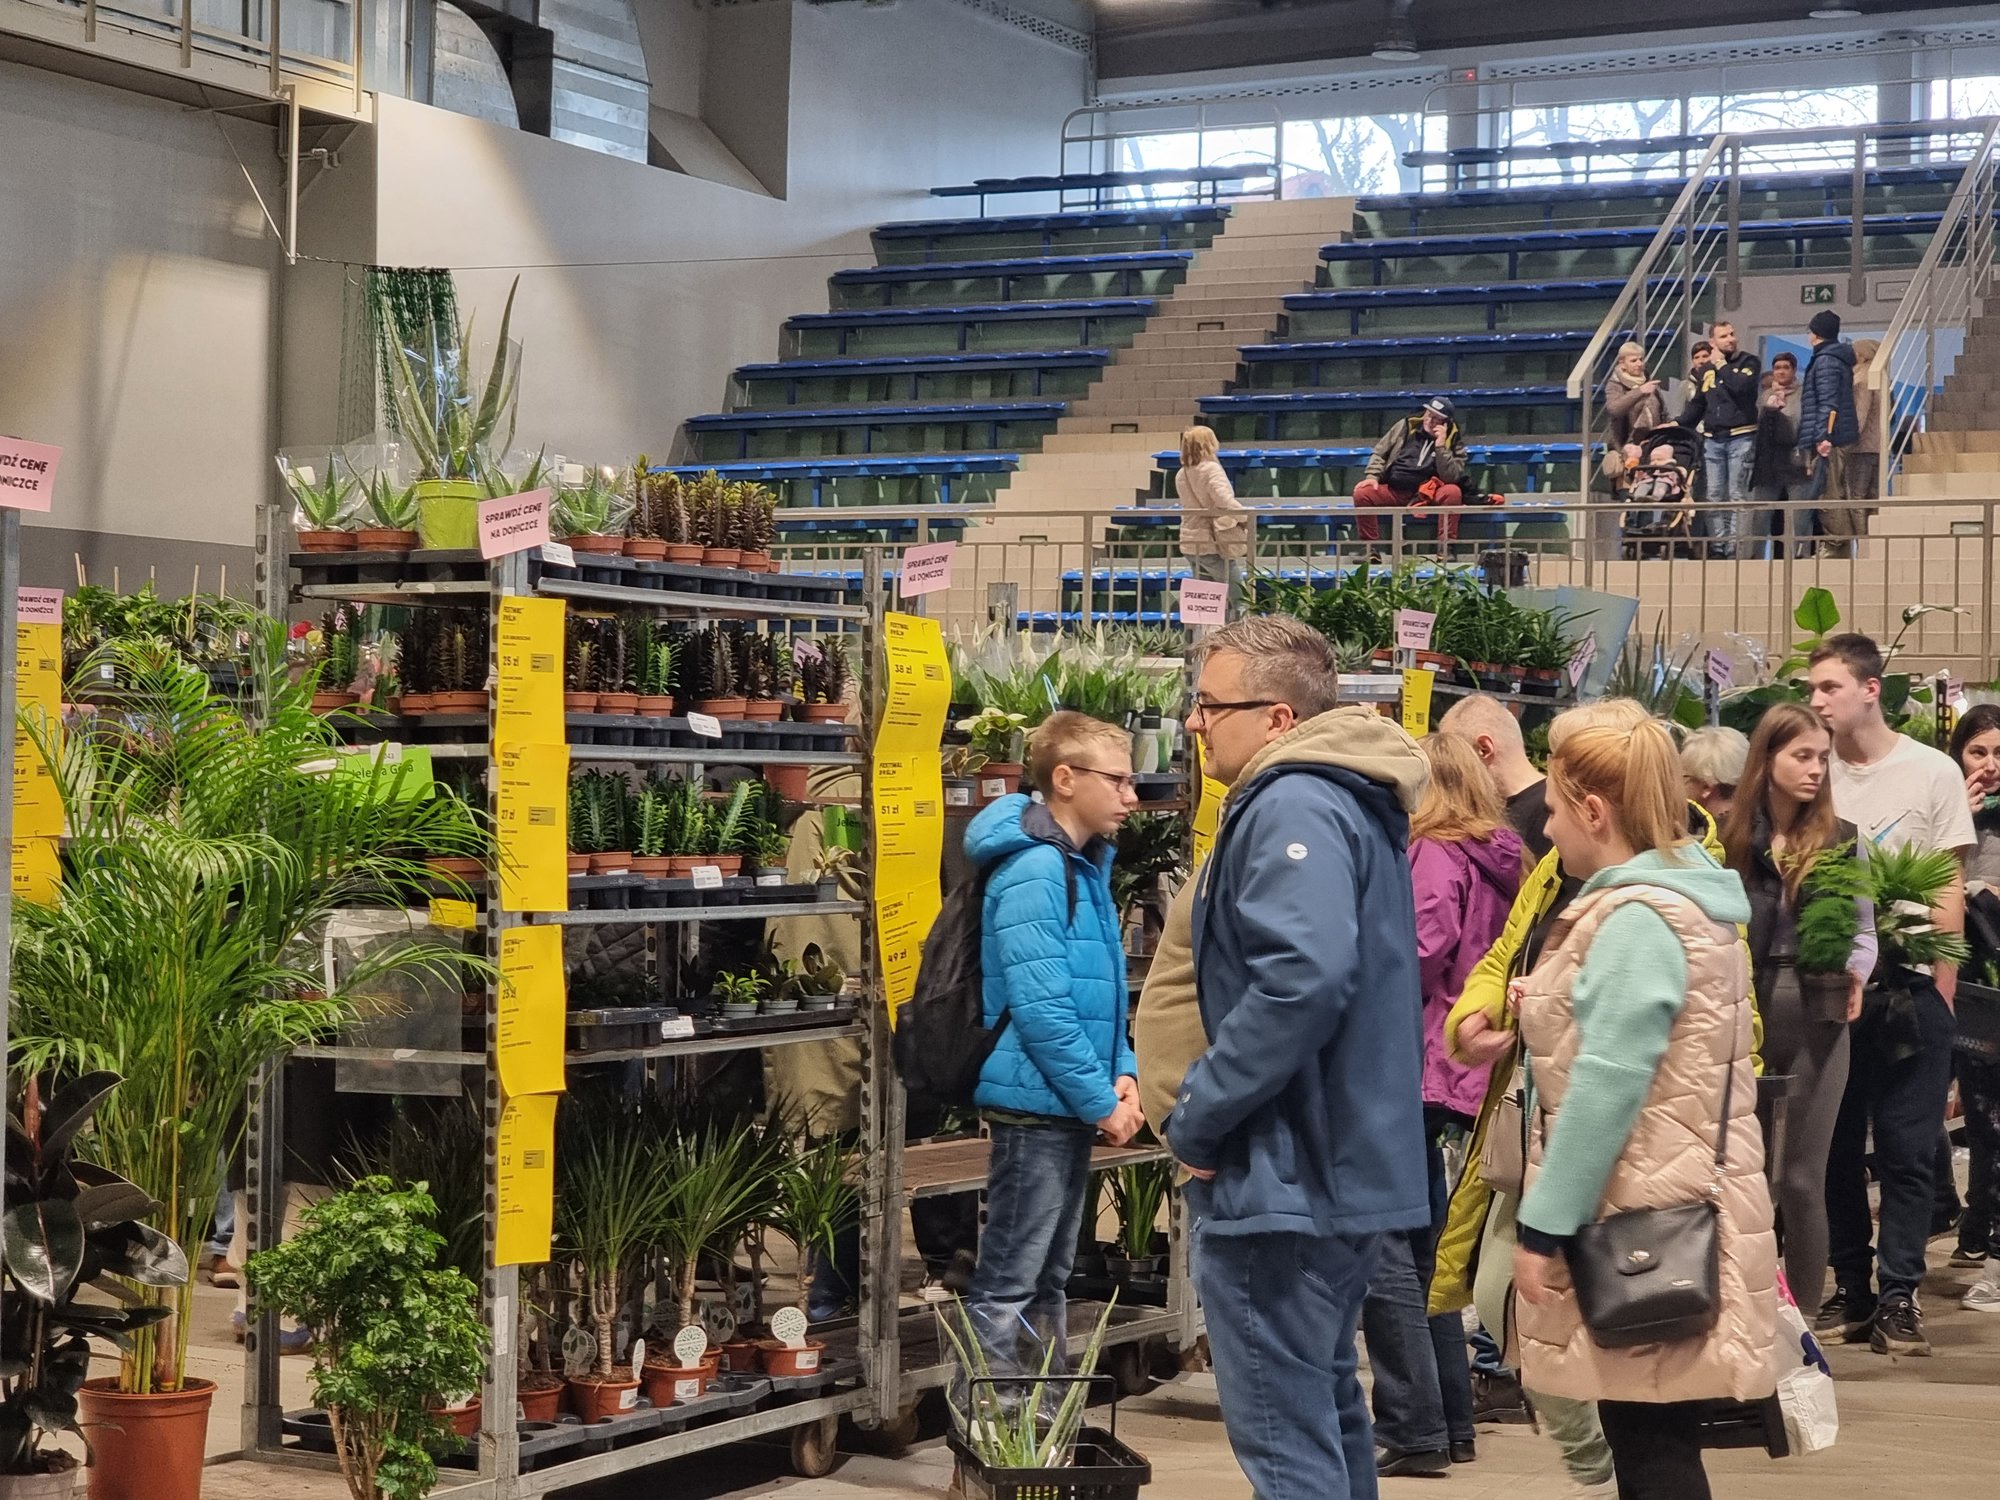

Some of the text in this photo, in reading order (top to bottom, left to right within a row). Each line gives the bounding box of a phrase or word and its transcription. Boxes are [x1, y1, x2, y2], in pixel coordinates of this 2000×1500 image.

[20, 458, 48, 475] CENĘ
[485, 502, 542, 524] SPRAWDŹ CENĘ
[490, 519, 539, 539] NA DONICZCE
[895, 664, 904, 673] 38
[906, 664, 912, 674] zł
[881, 804, 899, 815] 51 zł
[888, 948, 907, 963] 49 zł
